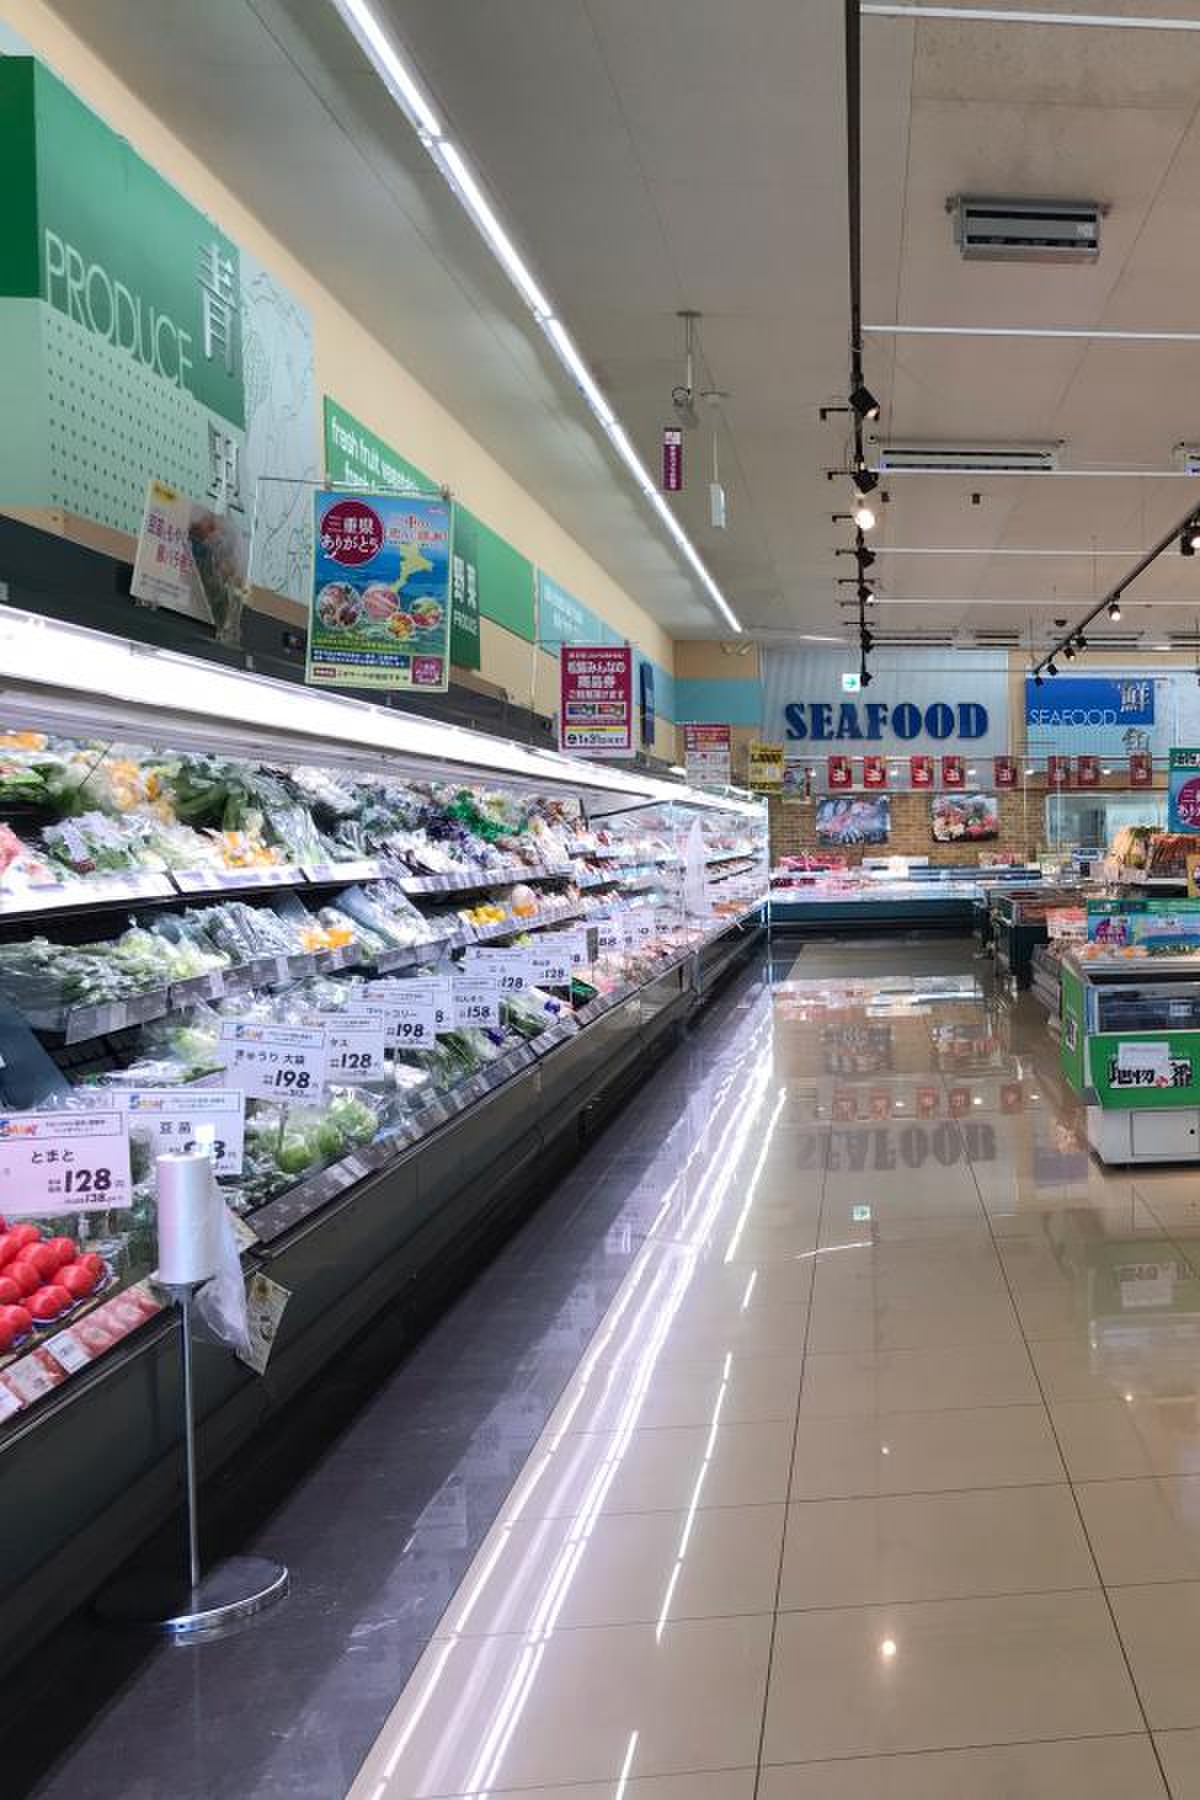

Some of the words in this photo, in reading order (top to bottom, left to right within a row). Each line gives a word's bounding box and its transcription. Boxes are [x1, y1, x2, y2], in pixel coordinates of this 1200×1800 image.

[45, 226, 193, 391] PRODUCE
[320, 533, 382, 560] ありがとう
[784, 702, 989, 741] SEAFOOD
[1030, 708, 1118, 726] SEAFOOD
[466, 1005, 491, 1018] 158
[396, 1023, 424, 1037] 198
[341, 1053, 372, 1069] 128
[275, 1069, 311, 1089] 198
[31, 1149, 75, 1164] とまと
[64, 1168, 112, 1193] 128
